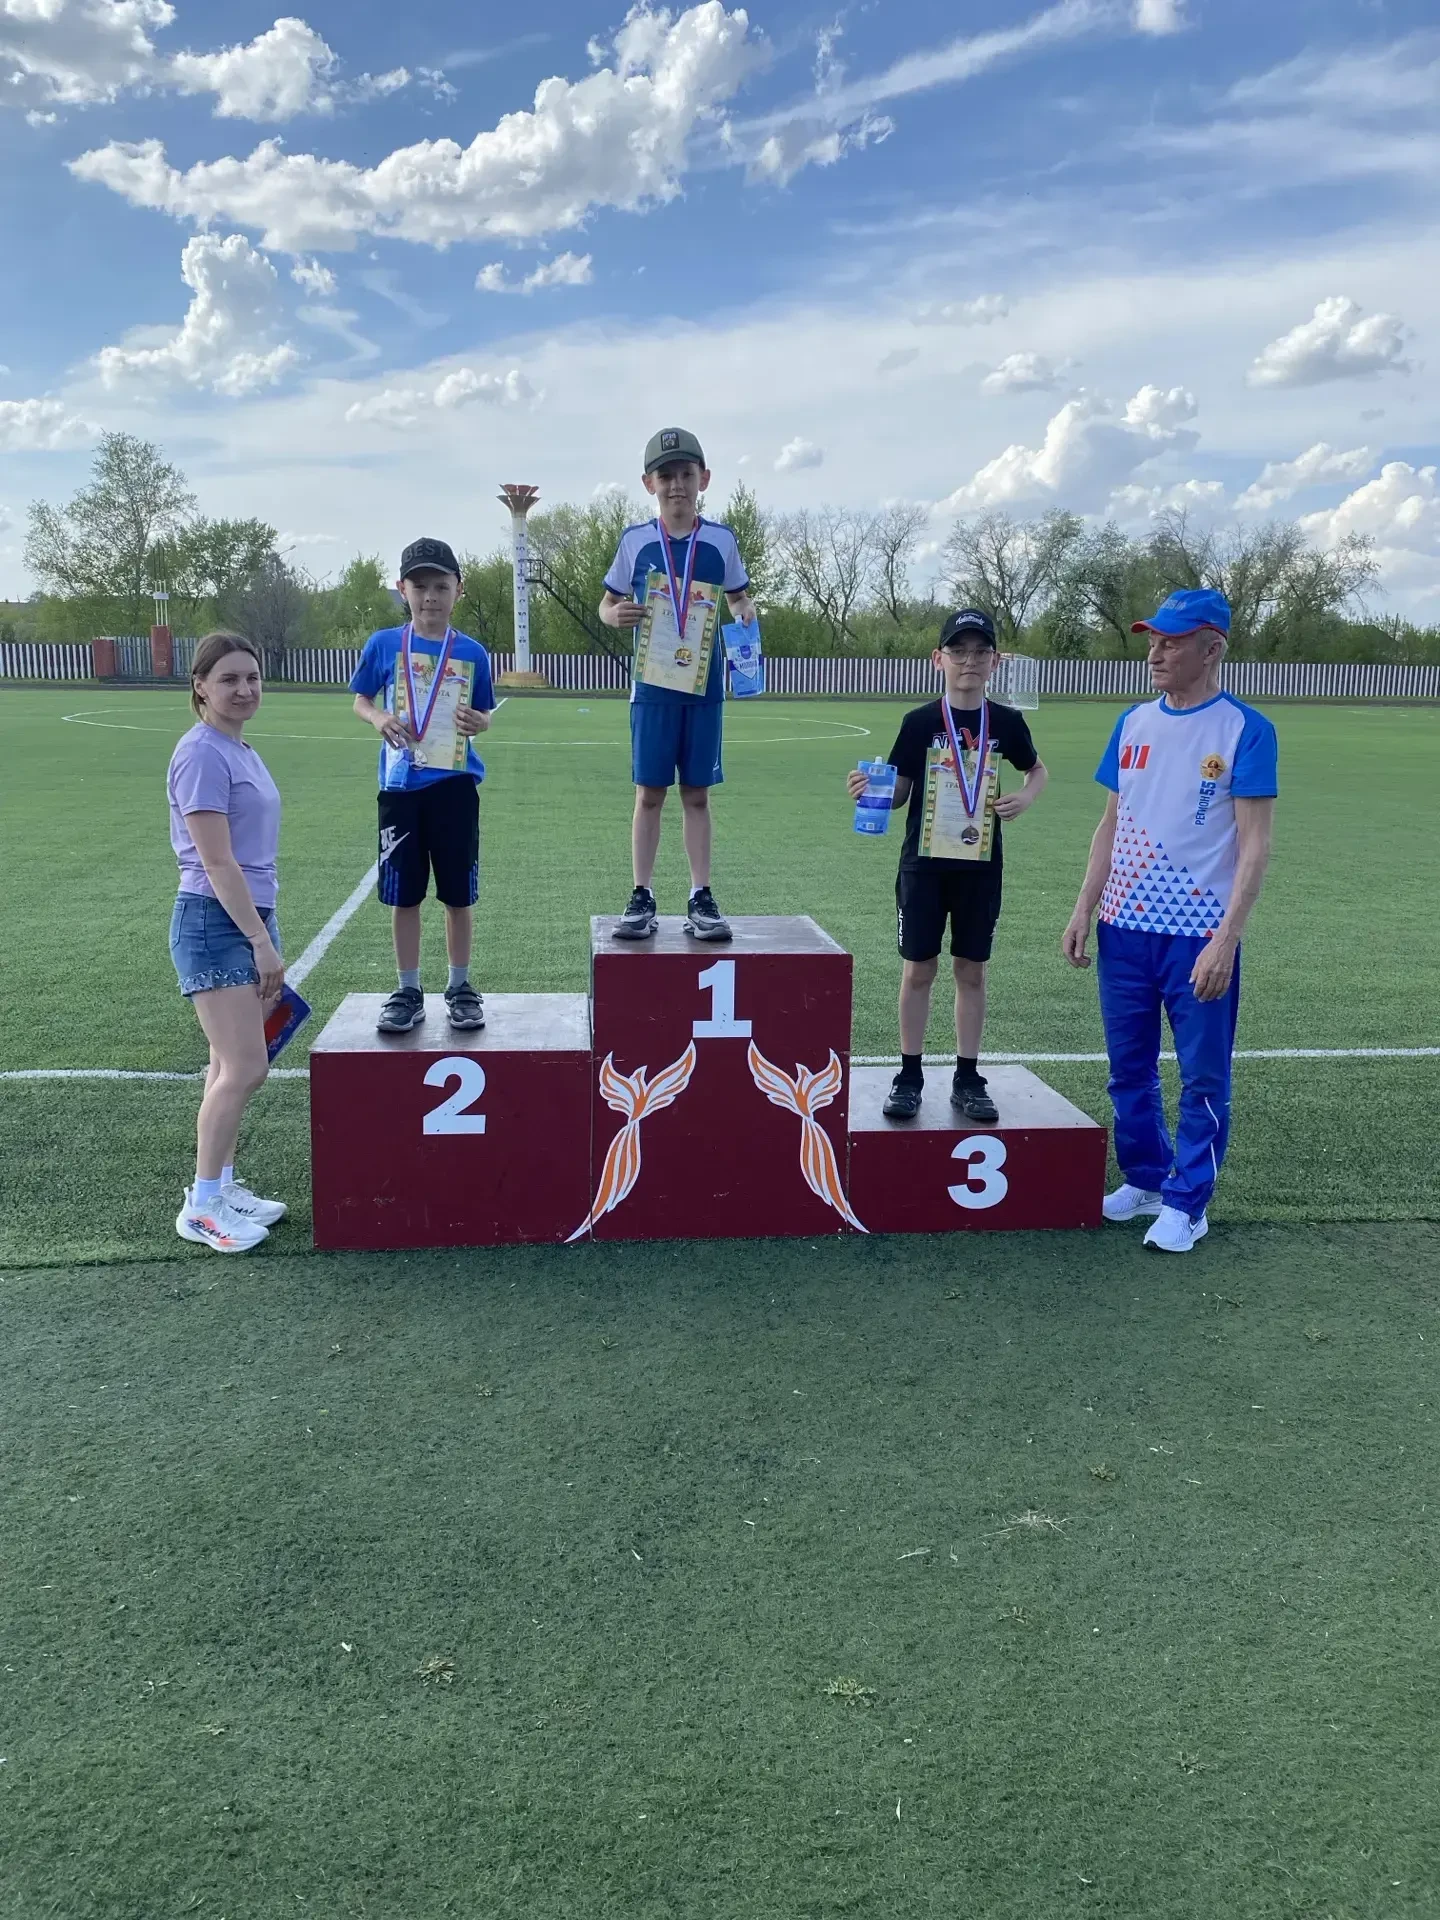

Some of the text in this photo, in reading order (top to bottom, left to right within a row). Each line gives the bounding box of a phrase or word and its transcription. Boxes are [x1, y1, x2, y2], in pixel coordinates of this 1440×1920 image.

[402, 541, 445, 562] BEST
[1195, 780, 1217, 826] РЕГИОН 55
[692, 960, 752, 1038] 1
[422, 1057, 486, 1135] 2
[947, 1135, 1008, 1209] 3
